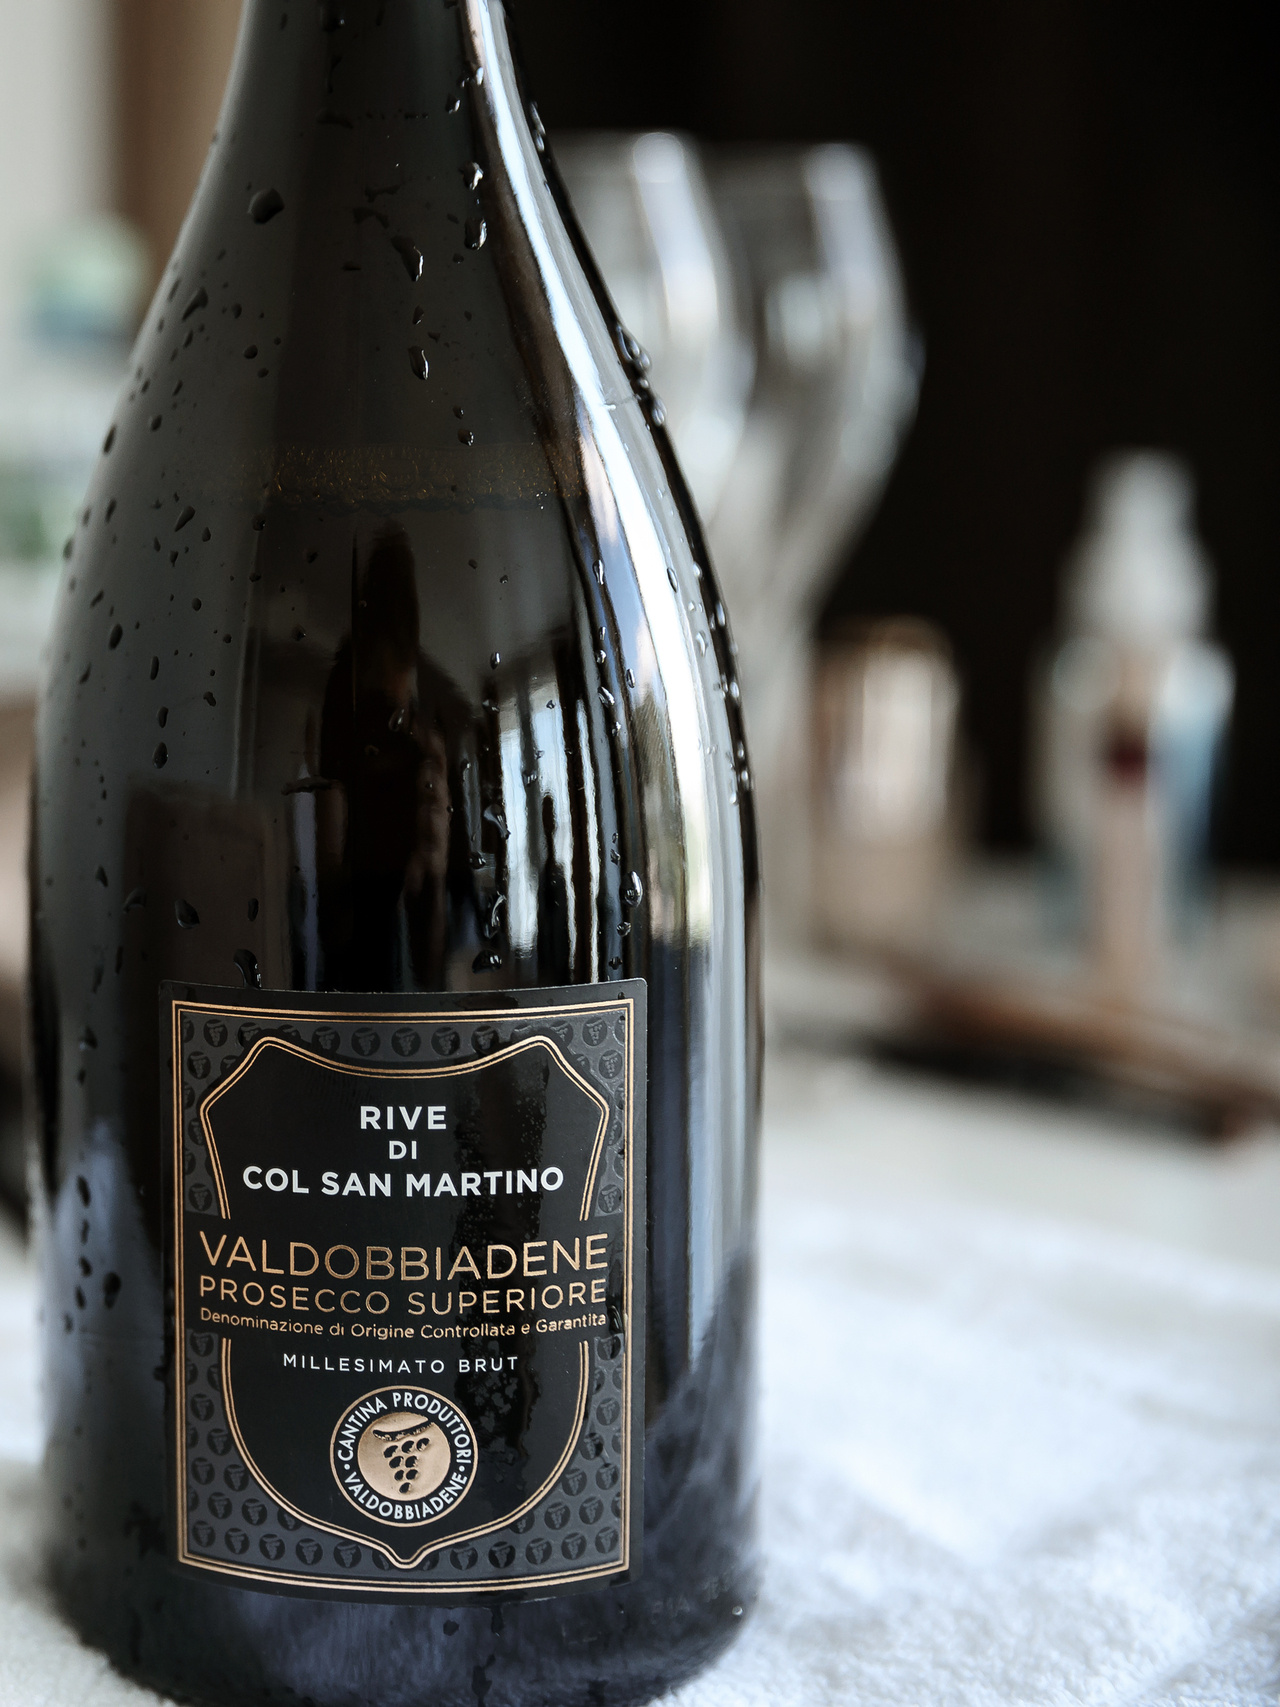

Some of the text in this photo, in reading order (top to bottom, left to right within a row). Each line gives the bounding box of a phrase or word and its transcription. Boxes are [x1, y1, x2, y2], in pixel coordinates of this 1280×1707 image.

[360, 1105, 447, 1130] RIVE
[389, 1140, 417, 1160] DI
[242, 1165, 564, 1197] COL SAN MARTINO
[199, 1230, 609, 1281] VALDOBBIADENE
[199, 1274, 607, 1316] PROSECCO SUPERIORE
[200, 1306, 607, 1341] Denominazione di Origine Controllata e Garantita
[282, 1353, 519, 1374] MILLESIMATO BRUT
[336, 1391, 472, 1464] CANTINA PRODUTTORI
[343, 1471, 468, 1521] VALDOBBIADENE
